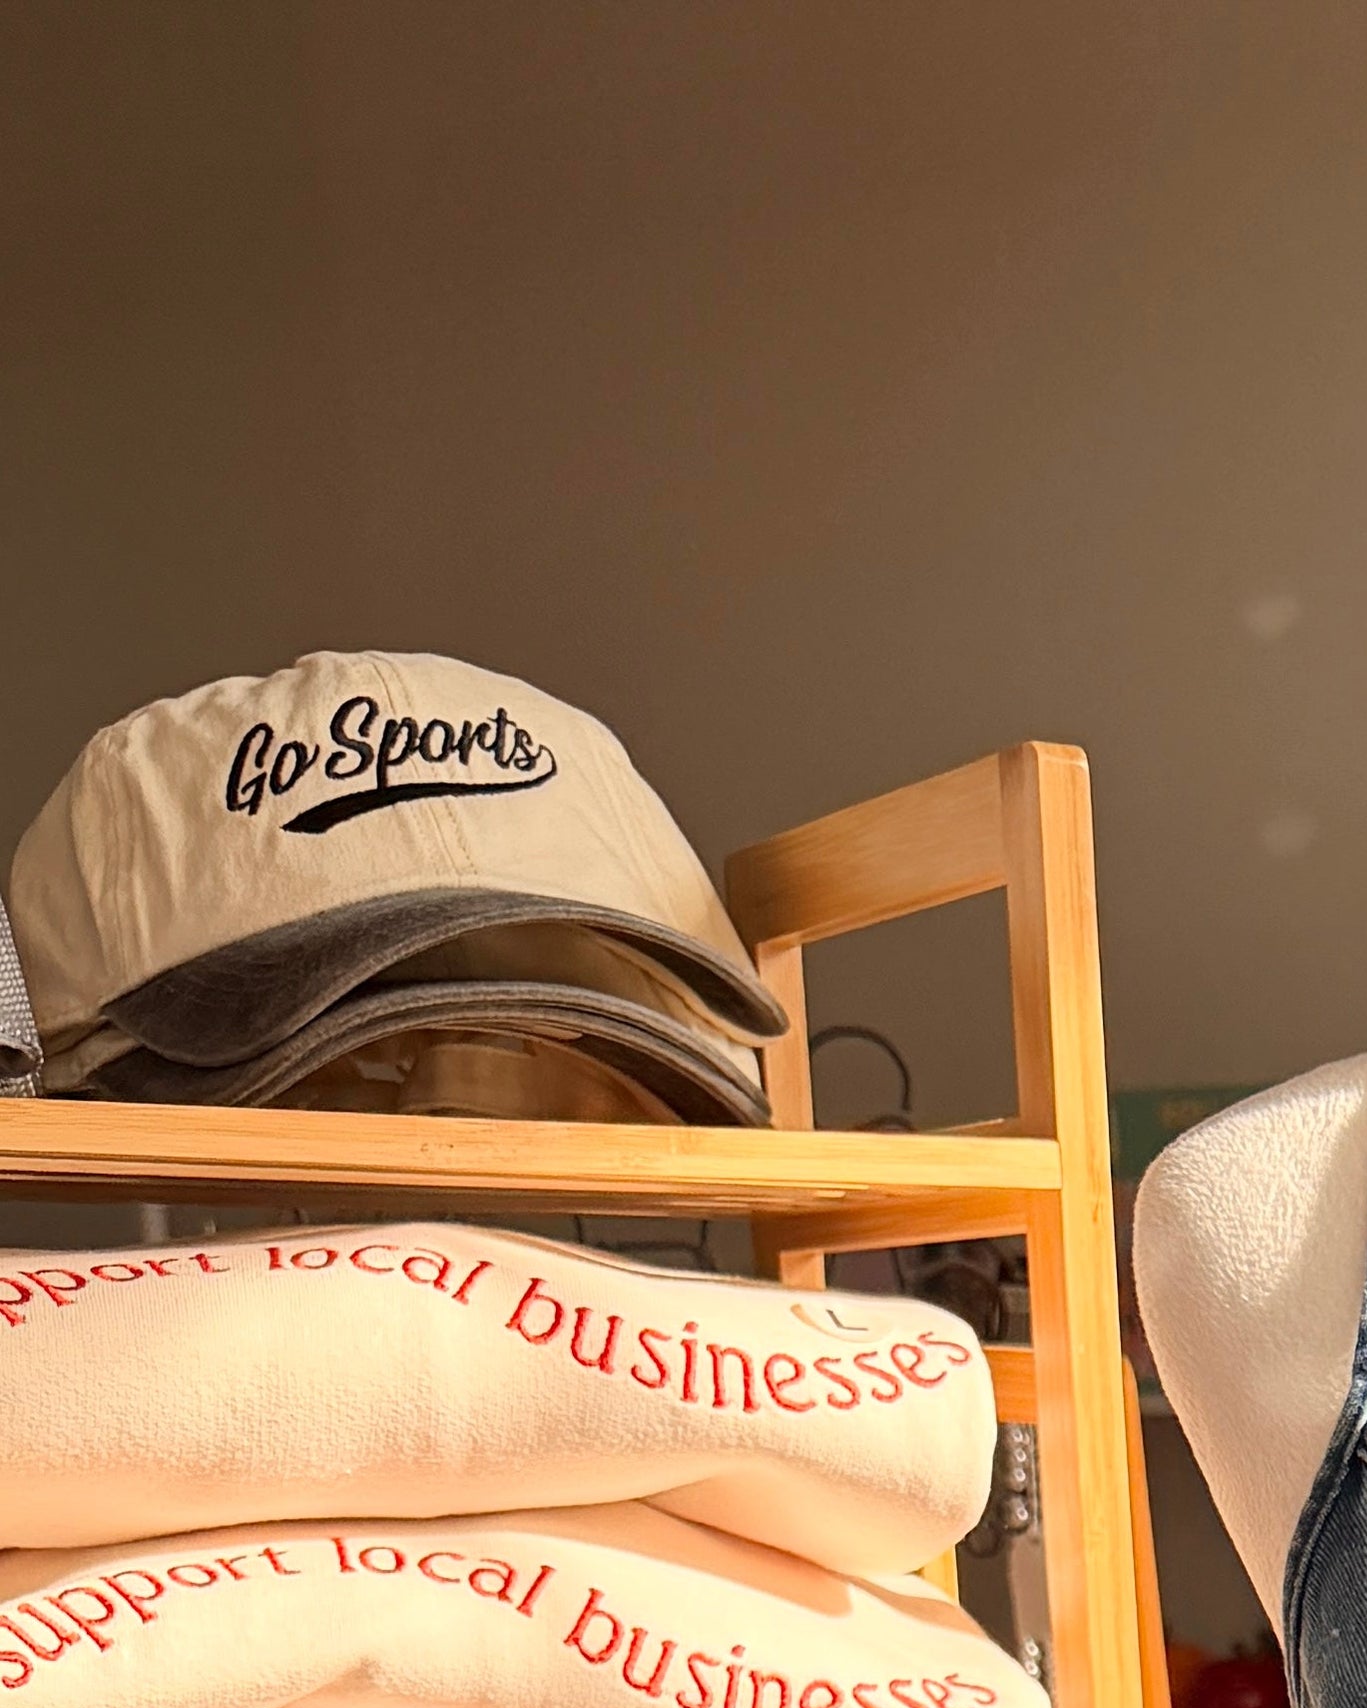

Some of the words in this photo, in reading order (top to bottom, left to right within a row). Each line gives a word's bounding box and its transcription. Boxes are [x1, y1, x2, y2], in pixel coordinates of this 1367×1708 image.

[226, 722, 320, 816] Go
[325, 695, 545, 790] Sports
[0, 1252, 231, 1328] pport
[264, 1244, 495, 1306] local
[505, 1277, 973, 1414] businesses
[826, 1308, 870, 1332] L
[0, 1546, 302, 1689] support
[332, 1536, 557, 1618] local
